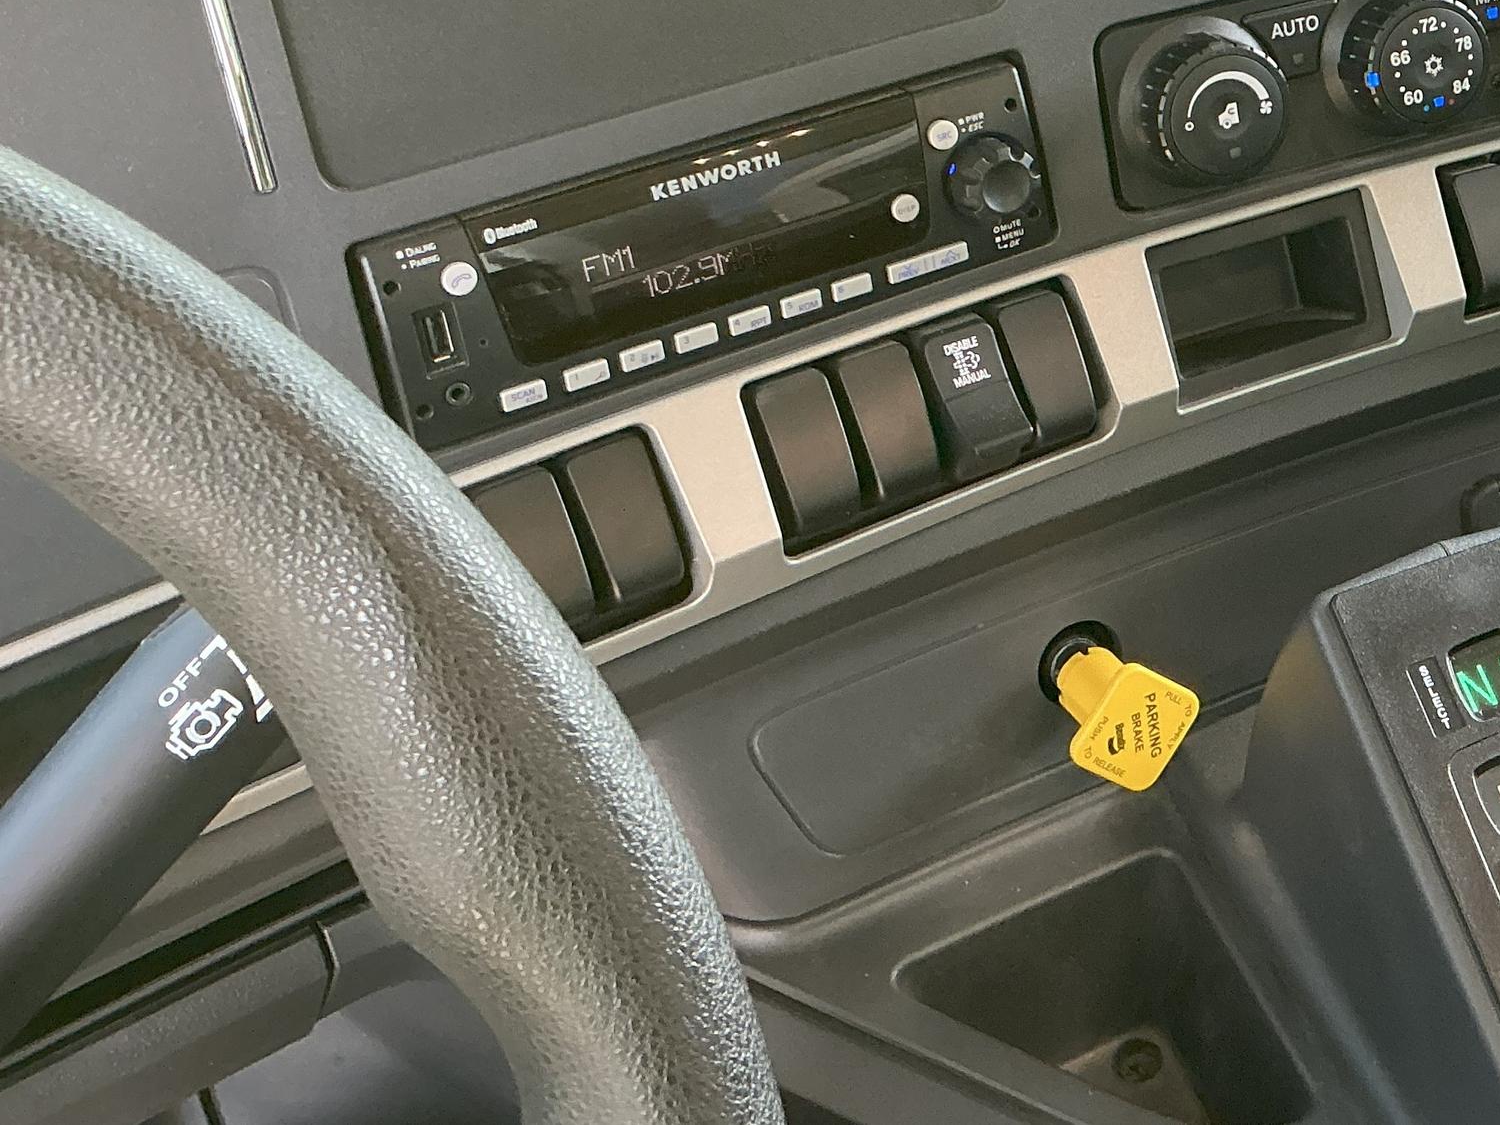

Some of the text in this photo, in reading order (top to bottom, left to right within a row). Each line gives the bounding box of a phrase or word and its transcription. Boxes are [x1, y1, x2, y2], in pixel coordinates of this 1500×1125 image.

[1270, 14, 1320, 40] AUTO
[1418, 15, 1438, 34] 72
[1454, 35, 1474, 53] 78
[1389, 49, 1412, 67] 66
[1451, 77, 1472, 95] 84
[1402, 90, 1424, 107] 60
[965, 112, 984, 123] PWR
[968, 121, 984, 132] ESC
[648, 150, 783, 204] KENWORTH
[1000, 219, 1021, 231] MUTE
[1001, 228, 1024, 241] MENU
[581, 245, 635, 282] FM1
[943, 335, 979, 356] DISABLE
[953, 368, 991, 389] MANUAL
[511, 387, 536, 401] SCAN
[158, 657, 201, 707] OFF
[1456, 664, 1498, 714] N
[1165, 691, 1182, 706] PULL
[1417, 665, 1453, 730] SELECT
[1131, 712, 1144, 753] BRAKE
[1144, 692, 1162, 758] PARKING
[1093, 756, 1126, 778] RELEASE
